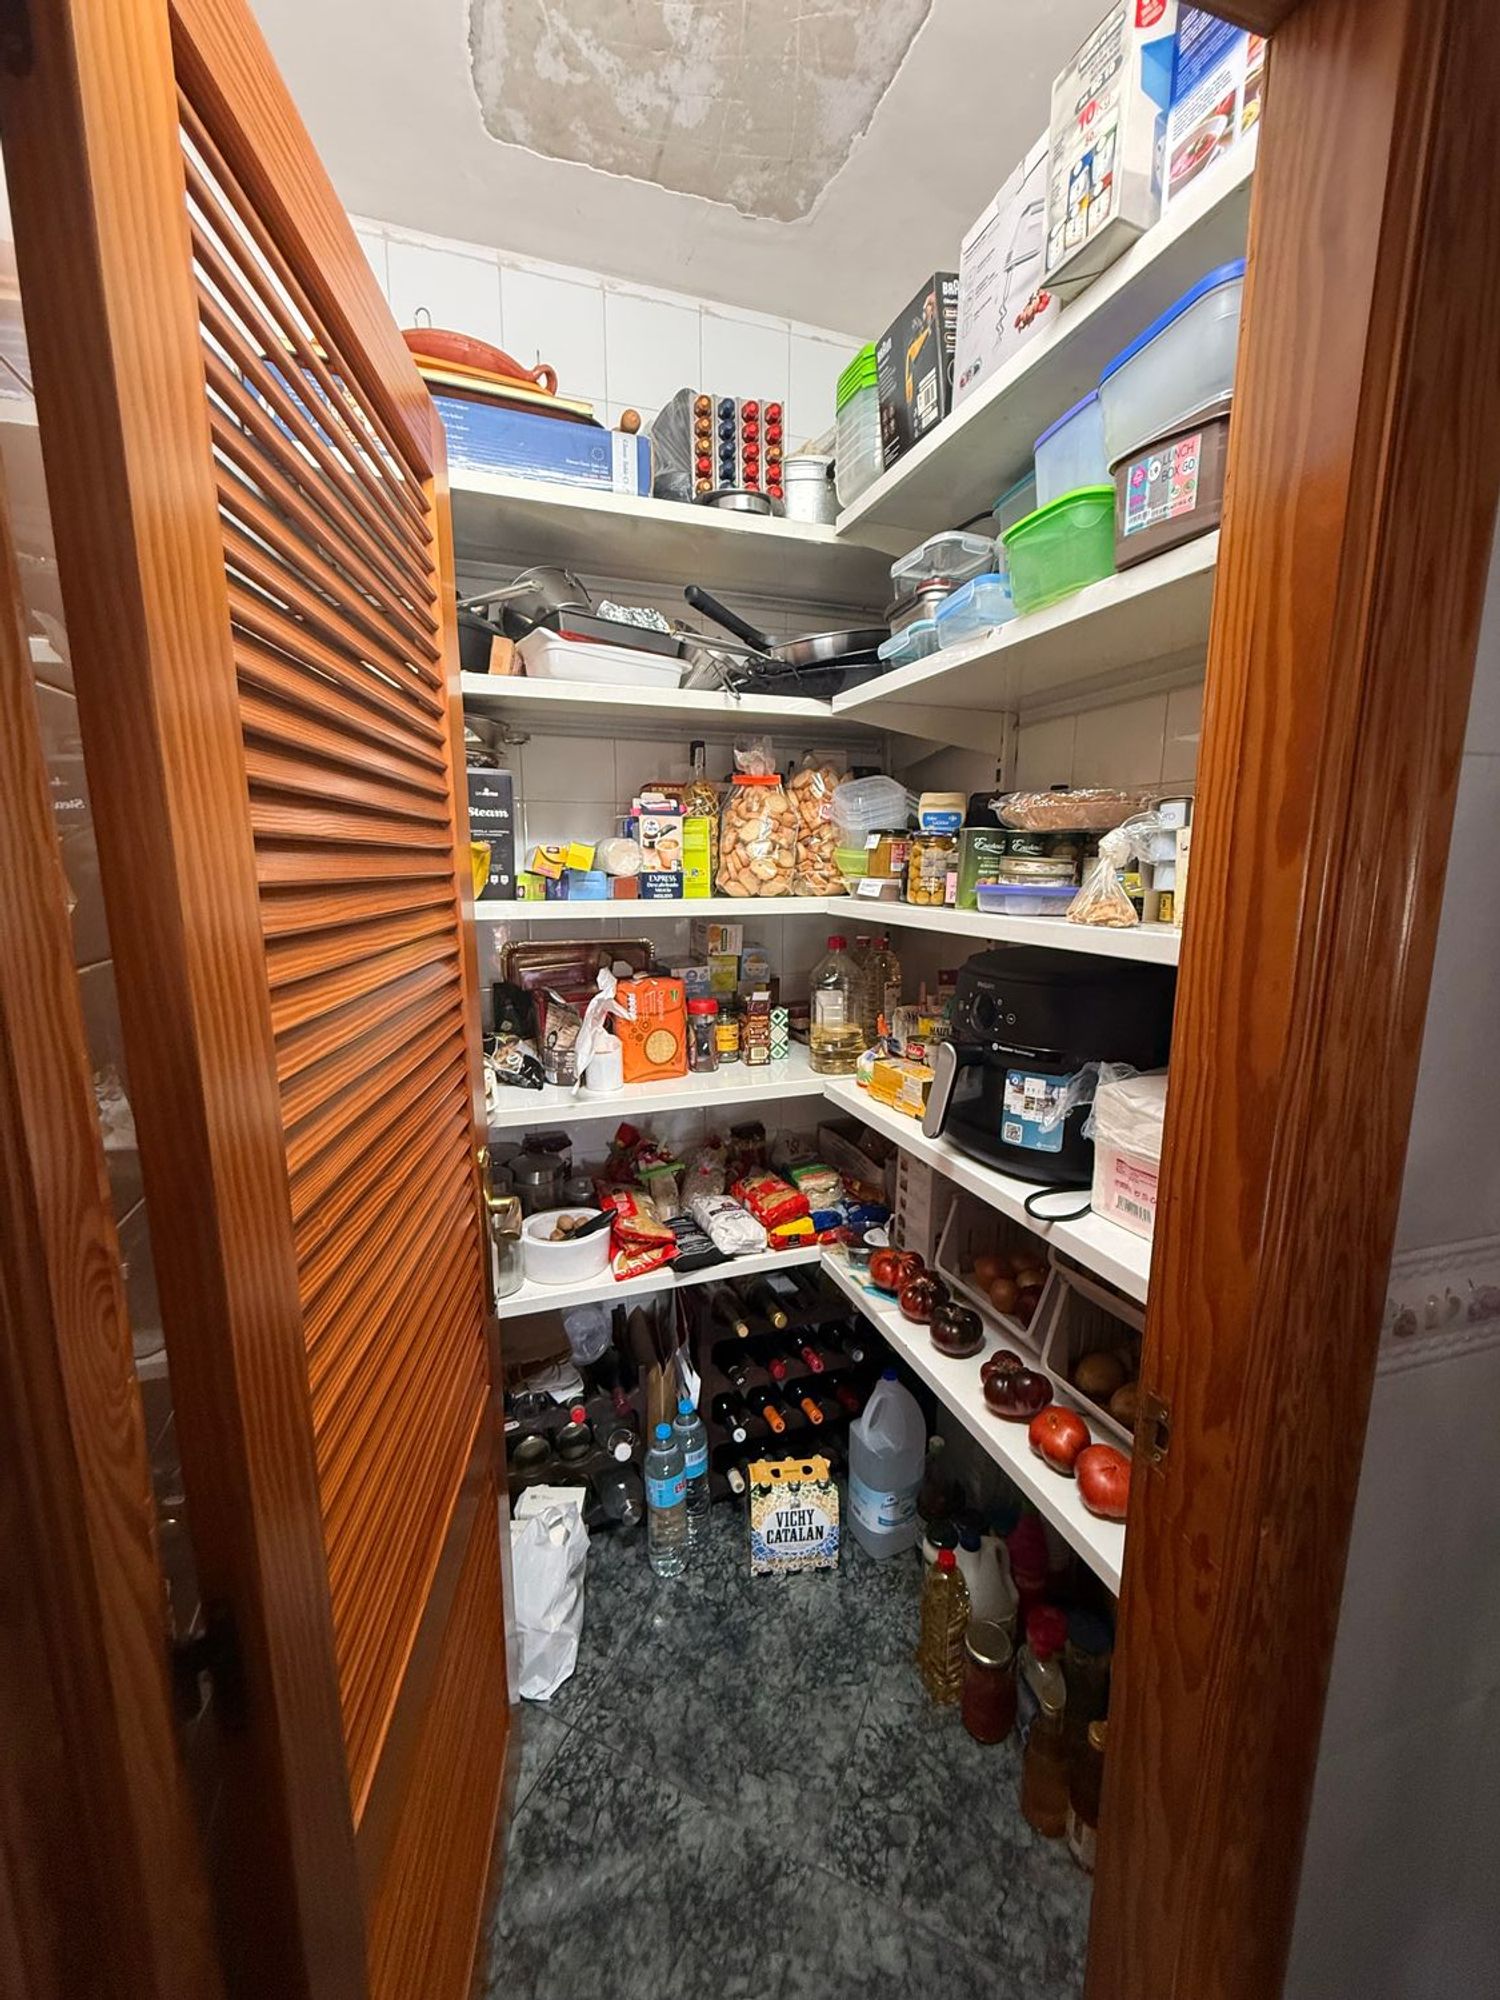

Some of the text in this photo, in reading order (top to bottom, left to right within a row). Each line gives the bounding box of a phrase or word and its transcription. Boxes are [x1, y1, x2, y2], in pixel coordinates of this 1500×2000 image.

[942, 279, 959, 295] BRA
[1161, 466, 1181, 482] BOX
[1182, 459, 1195, 472] GO
[468, 806, 509, 818] Steam
[776, 1509, 815, 1527] VICHY
[766, 1525, 824, 1544] CATALAN
